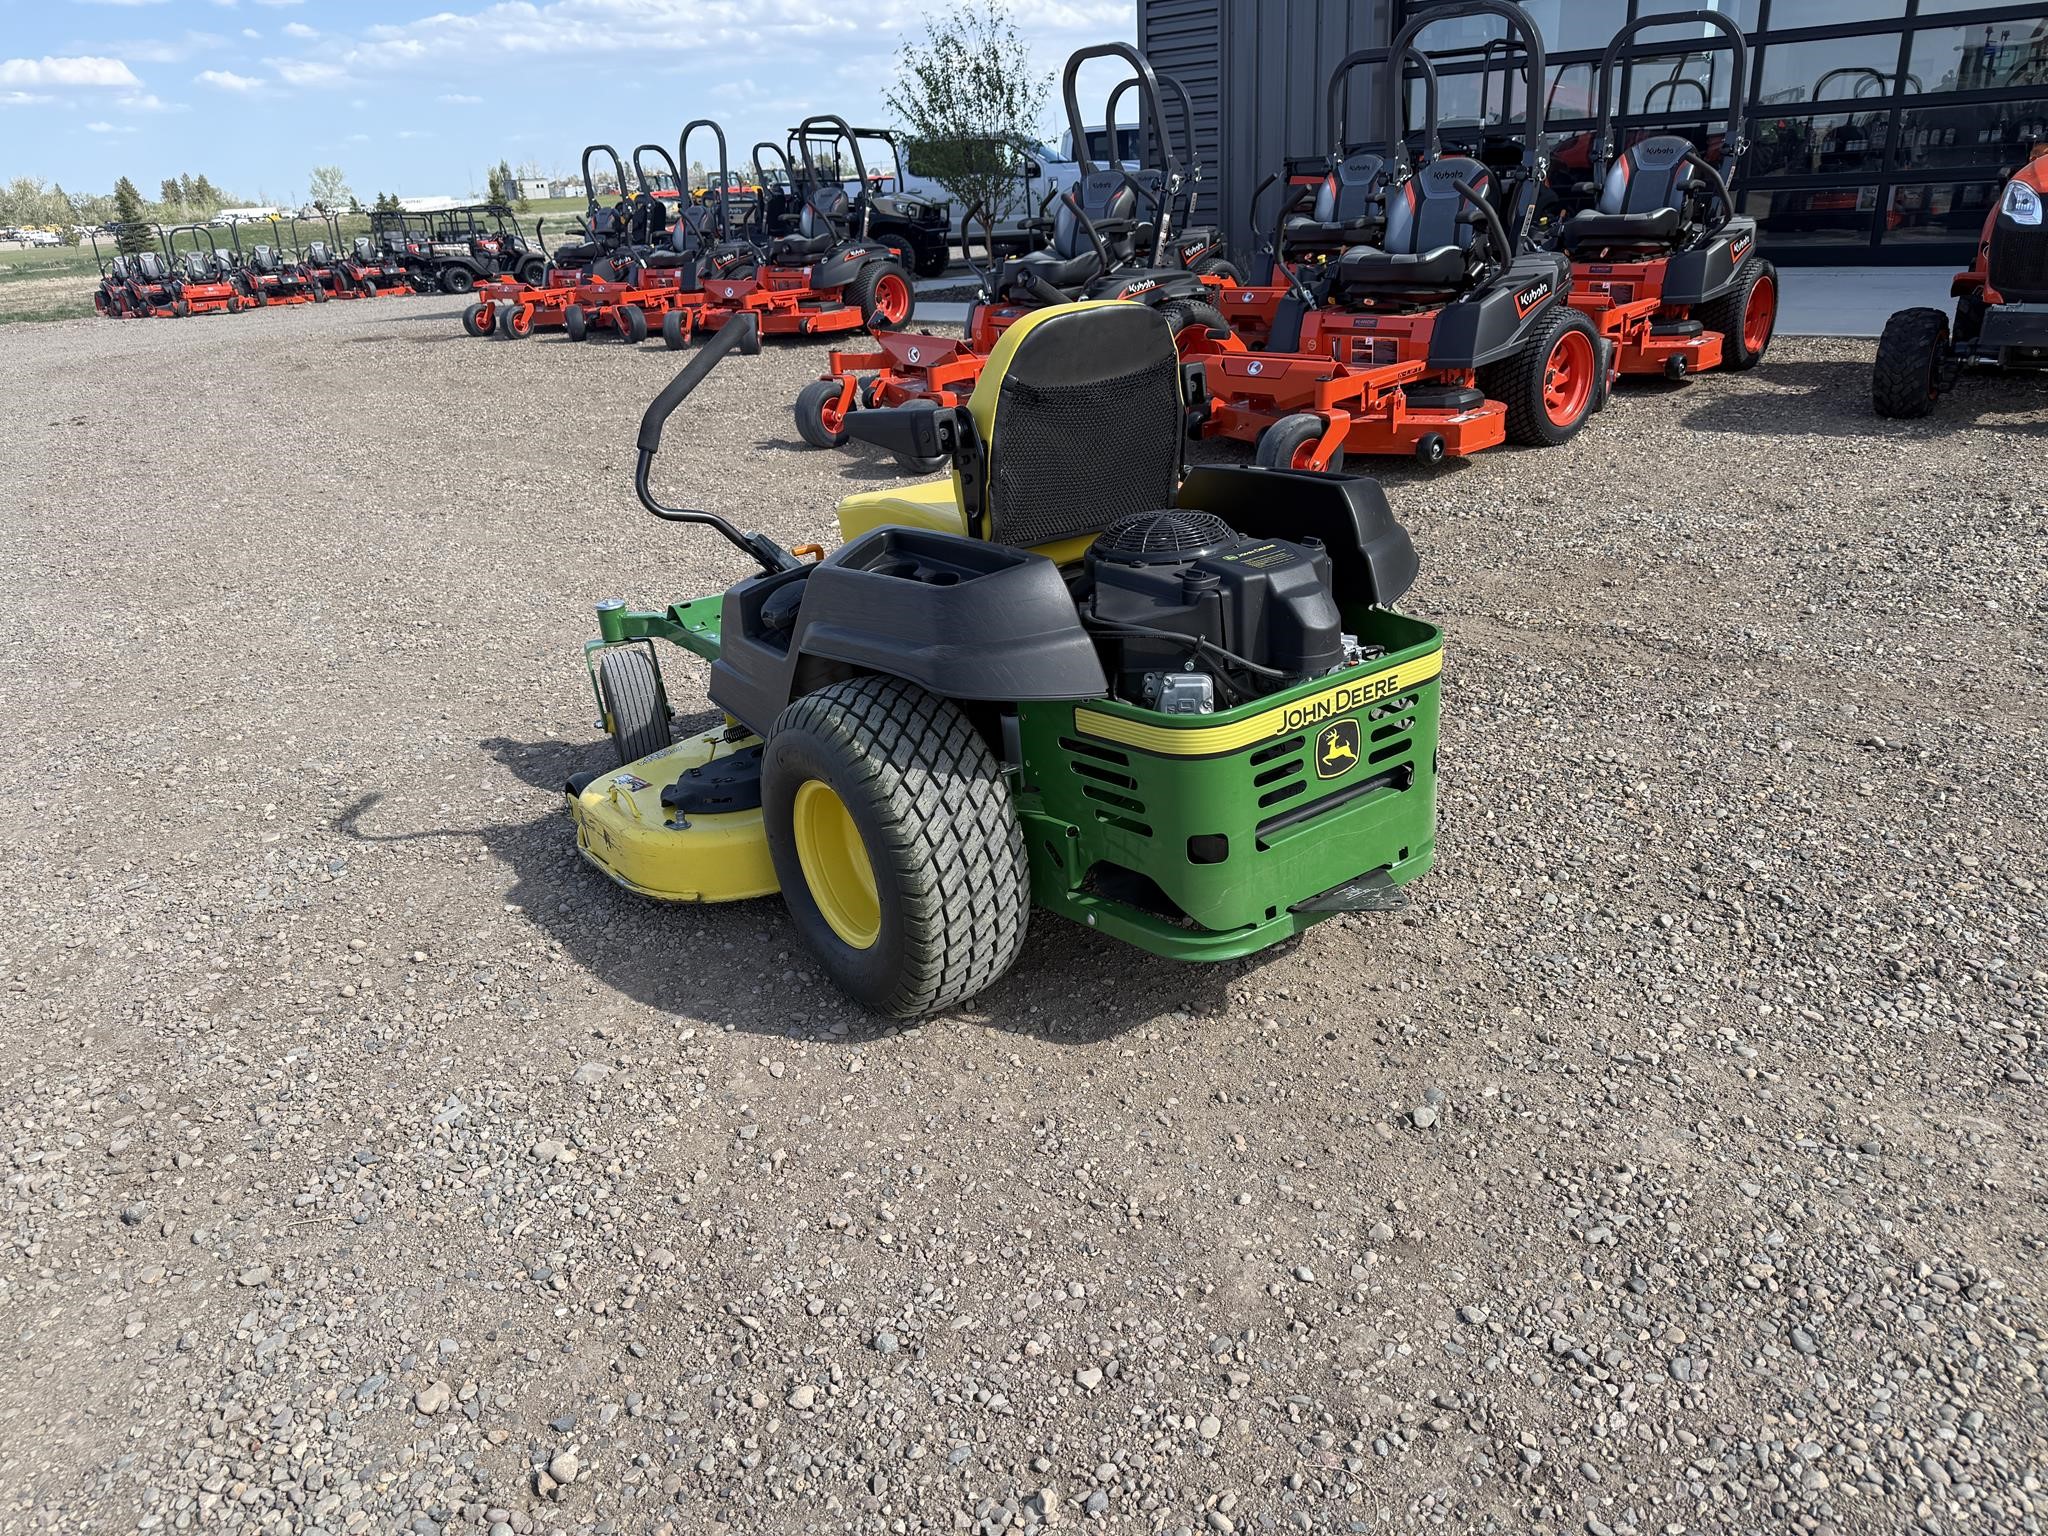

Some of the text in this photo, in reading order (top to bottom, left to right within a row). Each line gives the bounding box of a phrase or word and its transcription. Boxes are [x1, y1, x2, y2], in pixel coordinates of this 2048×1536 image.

[1646, 146, 1674, 155] Kubota
[1433, 170, 1464, 179] Kubota
[1185, 242, 1204, 256] Kubota
[1128, 279, 1156, 292] Kubota
[1520, 283, 1548, 305] Kubota
[1277, 674, 1399, 734] JOHN DEERE
